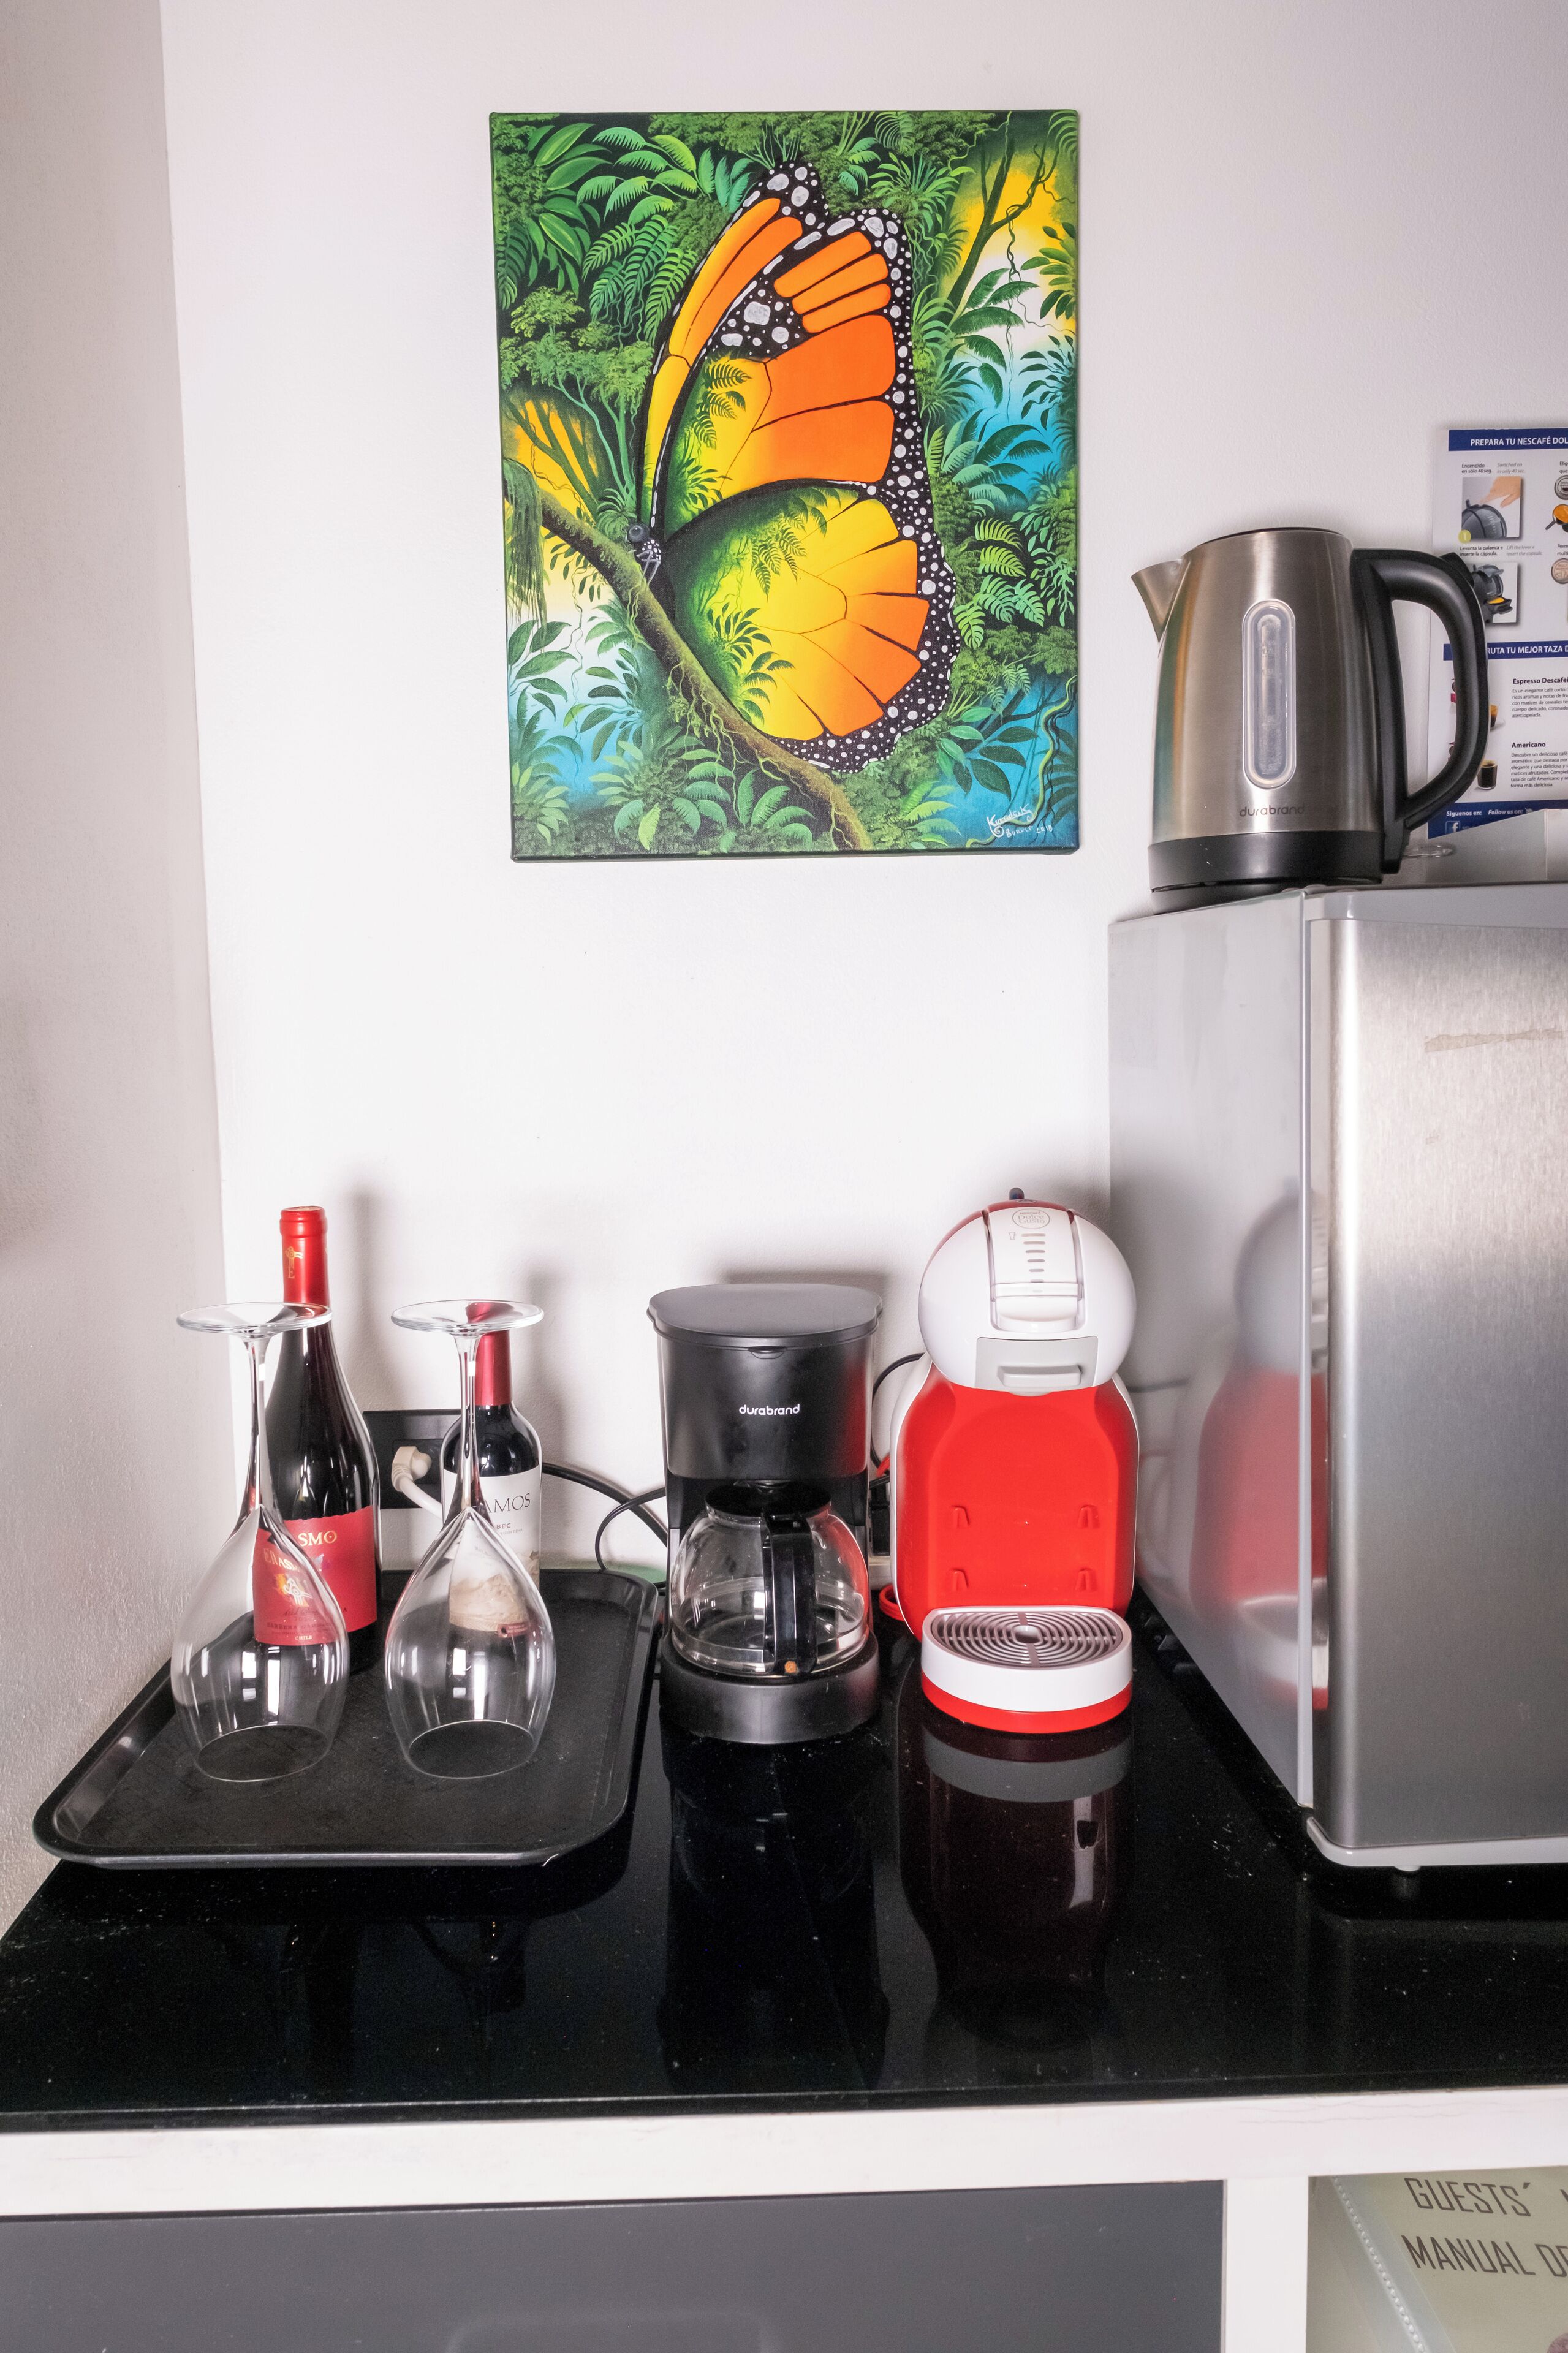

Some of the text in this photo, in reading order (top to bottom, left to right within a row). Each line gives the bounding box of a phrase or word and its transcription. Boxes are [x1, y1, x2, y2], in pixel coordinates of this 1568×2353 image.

[1517, 436, 1551, 445] NESCAFÉ
[1239, 803, 1305, 817] durabrand
[738, 1404, 800, 1415] durabrand
[298, 1531, 337, 1547] SMO
[1401, 2235, 1536, 2276] MANUAL
